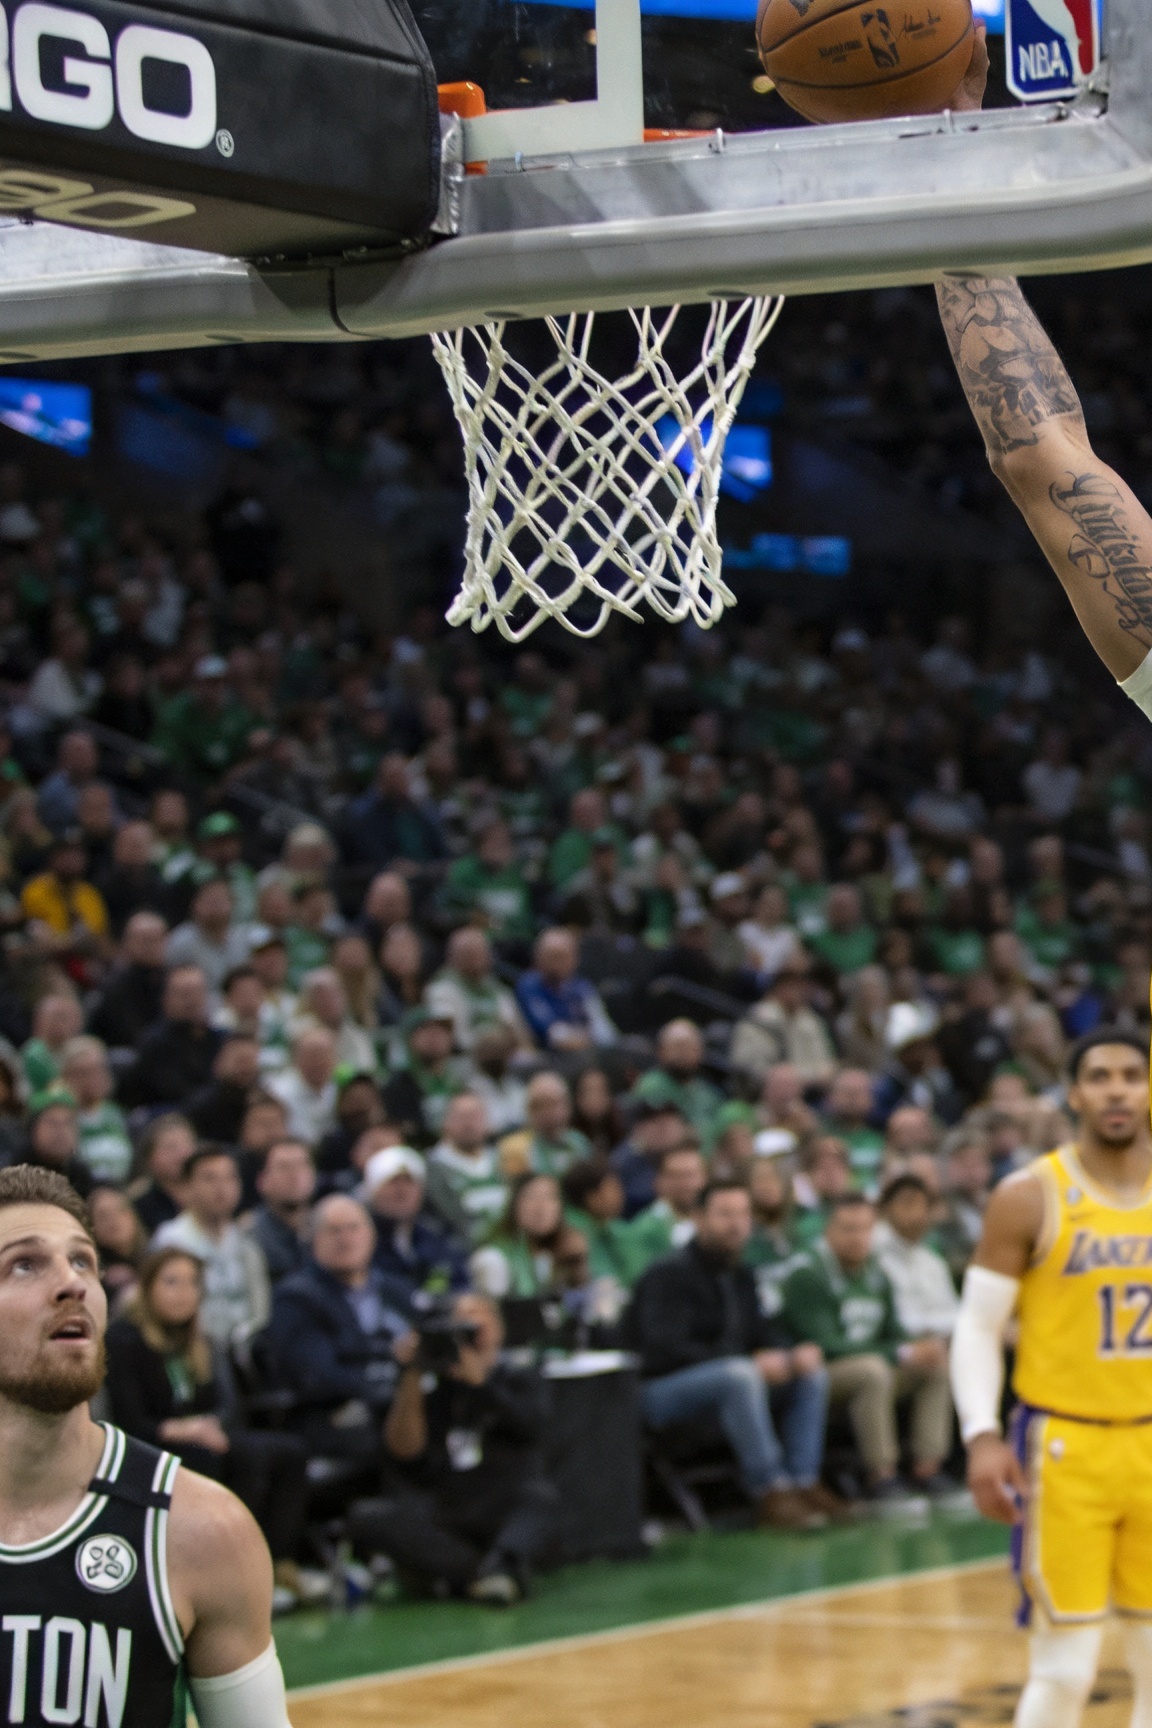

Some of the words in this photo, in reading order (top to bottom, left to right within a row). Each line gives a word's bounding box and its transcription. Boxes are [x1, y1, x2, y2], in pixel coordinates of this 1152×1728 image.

[0, 0, 217, 150] GO
[1018, 39, 1069, 82] NBA
[2, 1614, 132, 1728] TON
